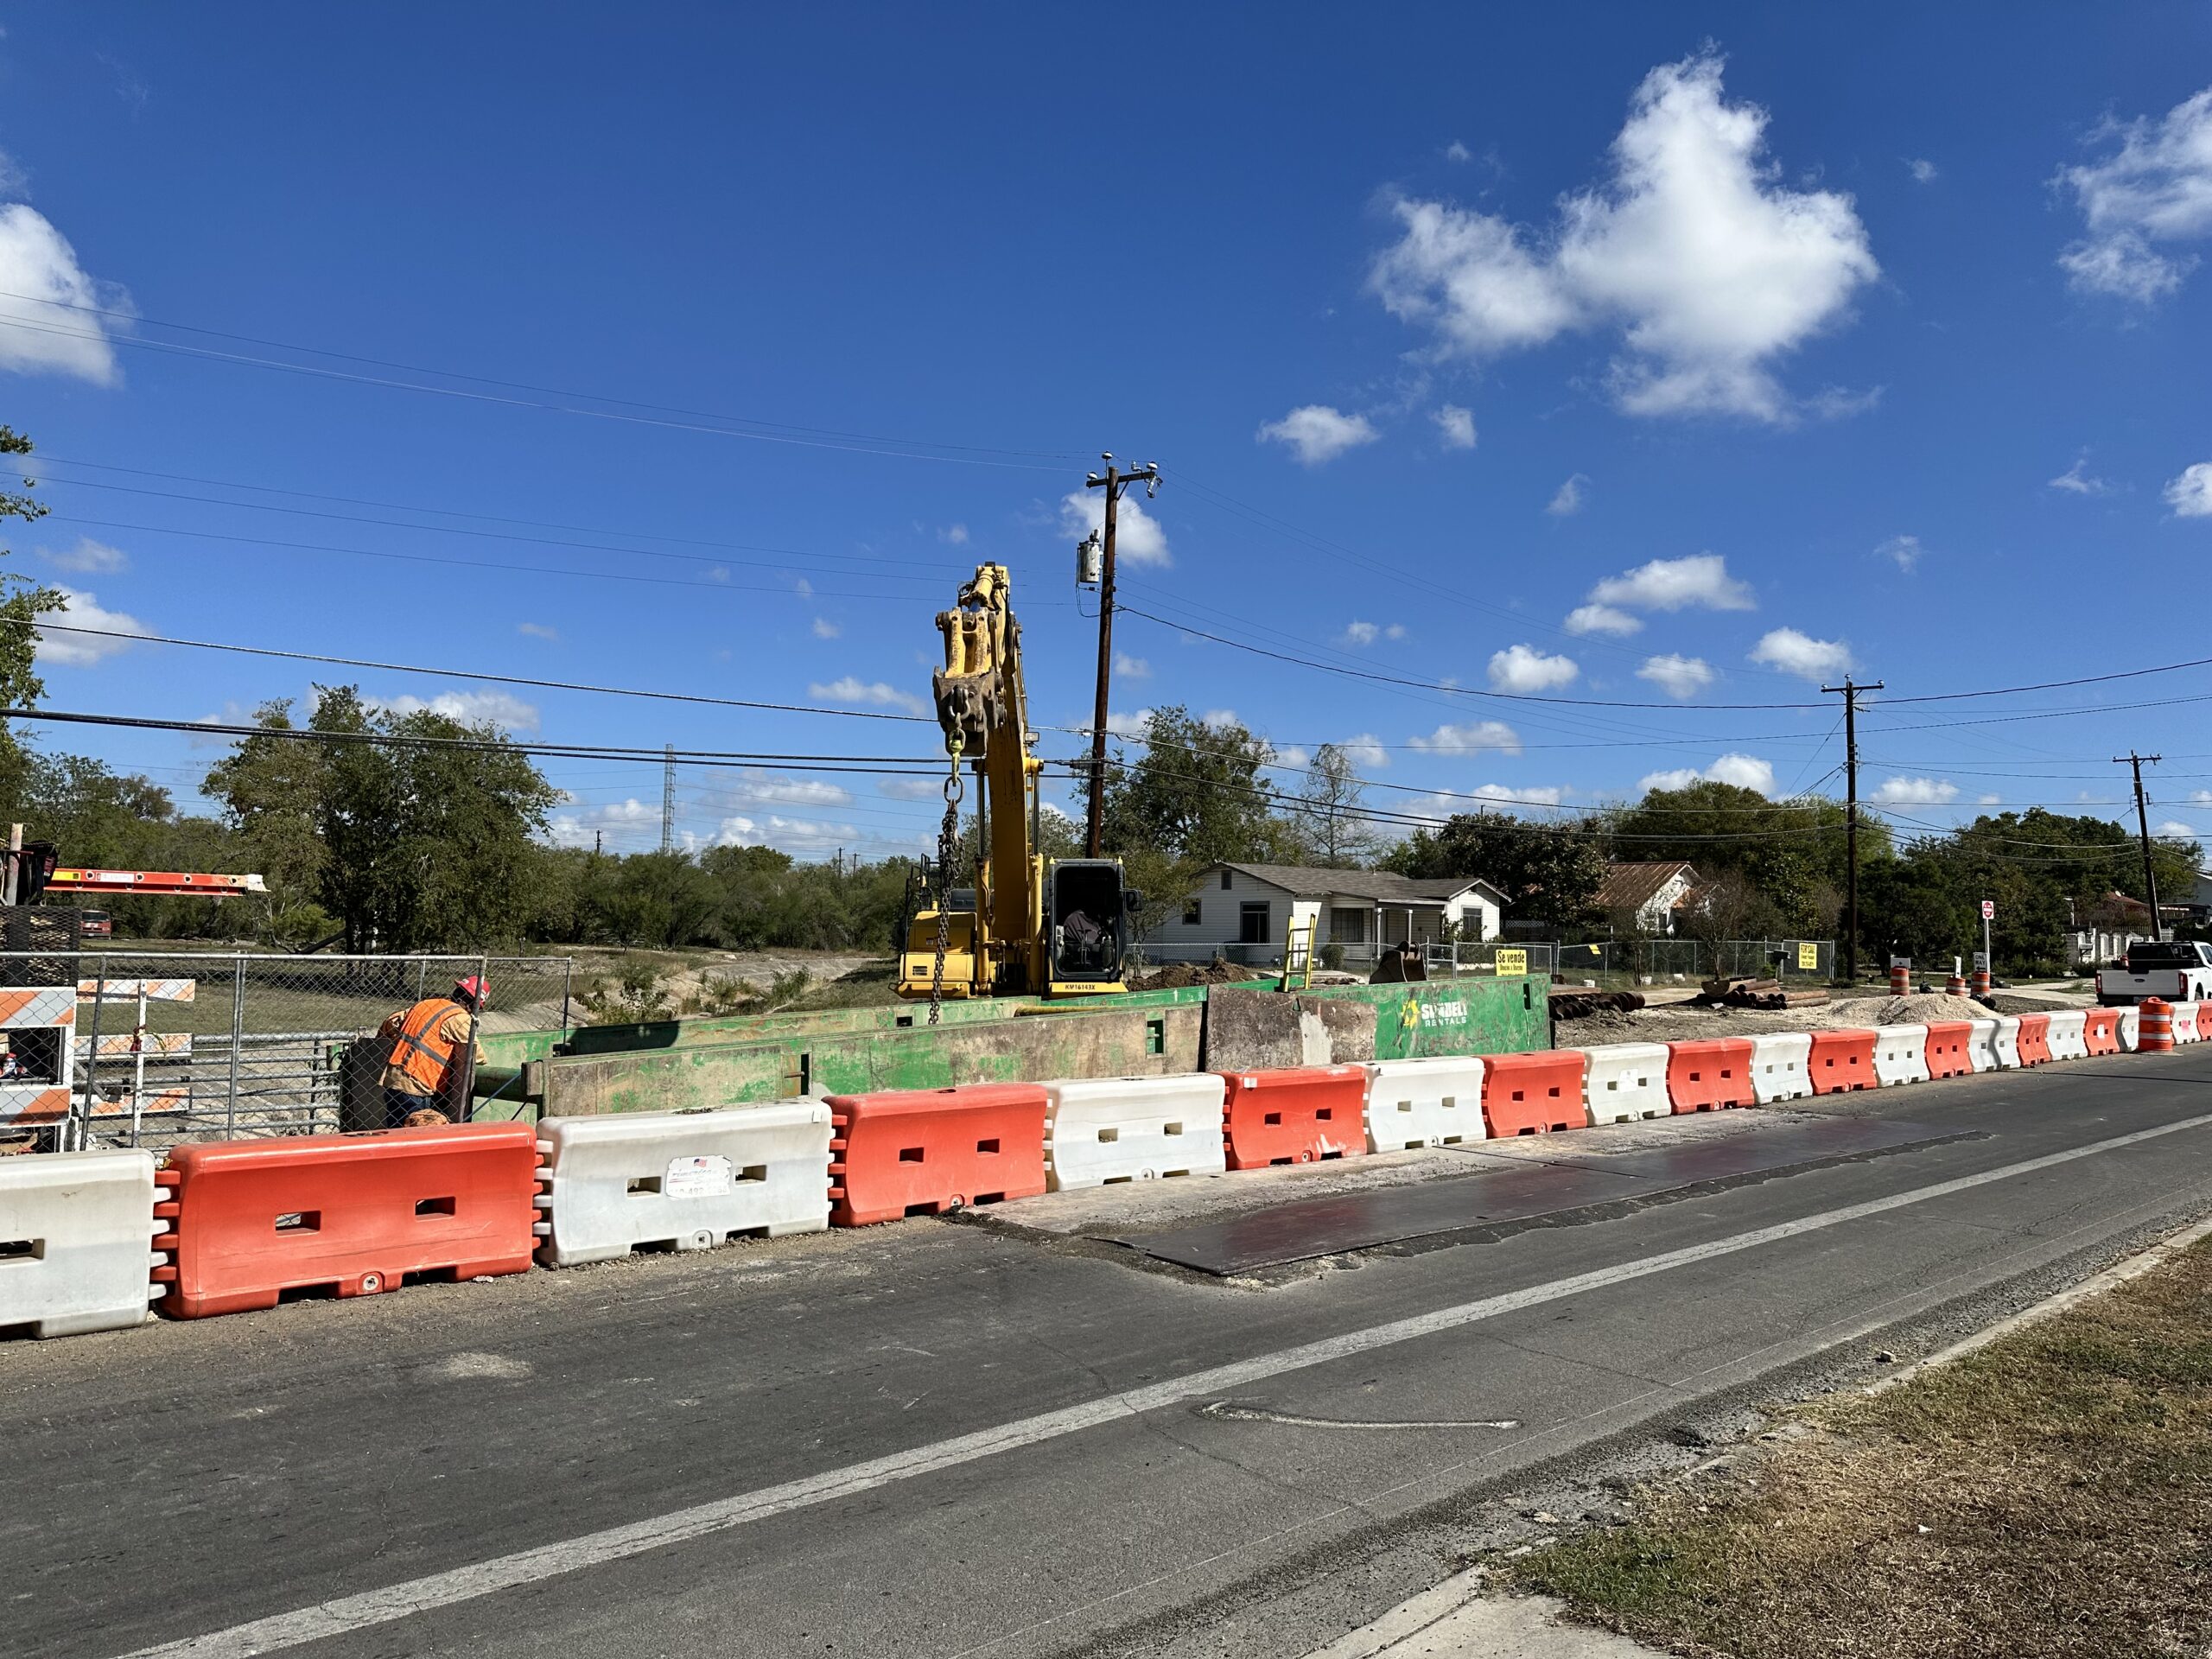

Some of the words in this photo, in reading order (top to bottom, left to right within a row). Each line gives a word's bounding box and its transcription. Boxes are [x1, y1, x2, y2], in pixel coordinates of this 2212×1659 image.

[1497, 950, 1505, 963] Se
[1507, 951, 1525, 963] vende
[1425, 1017, 1466, 1027] RENTALS
